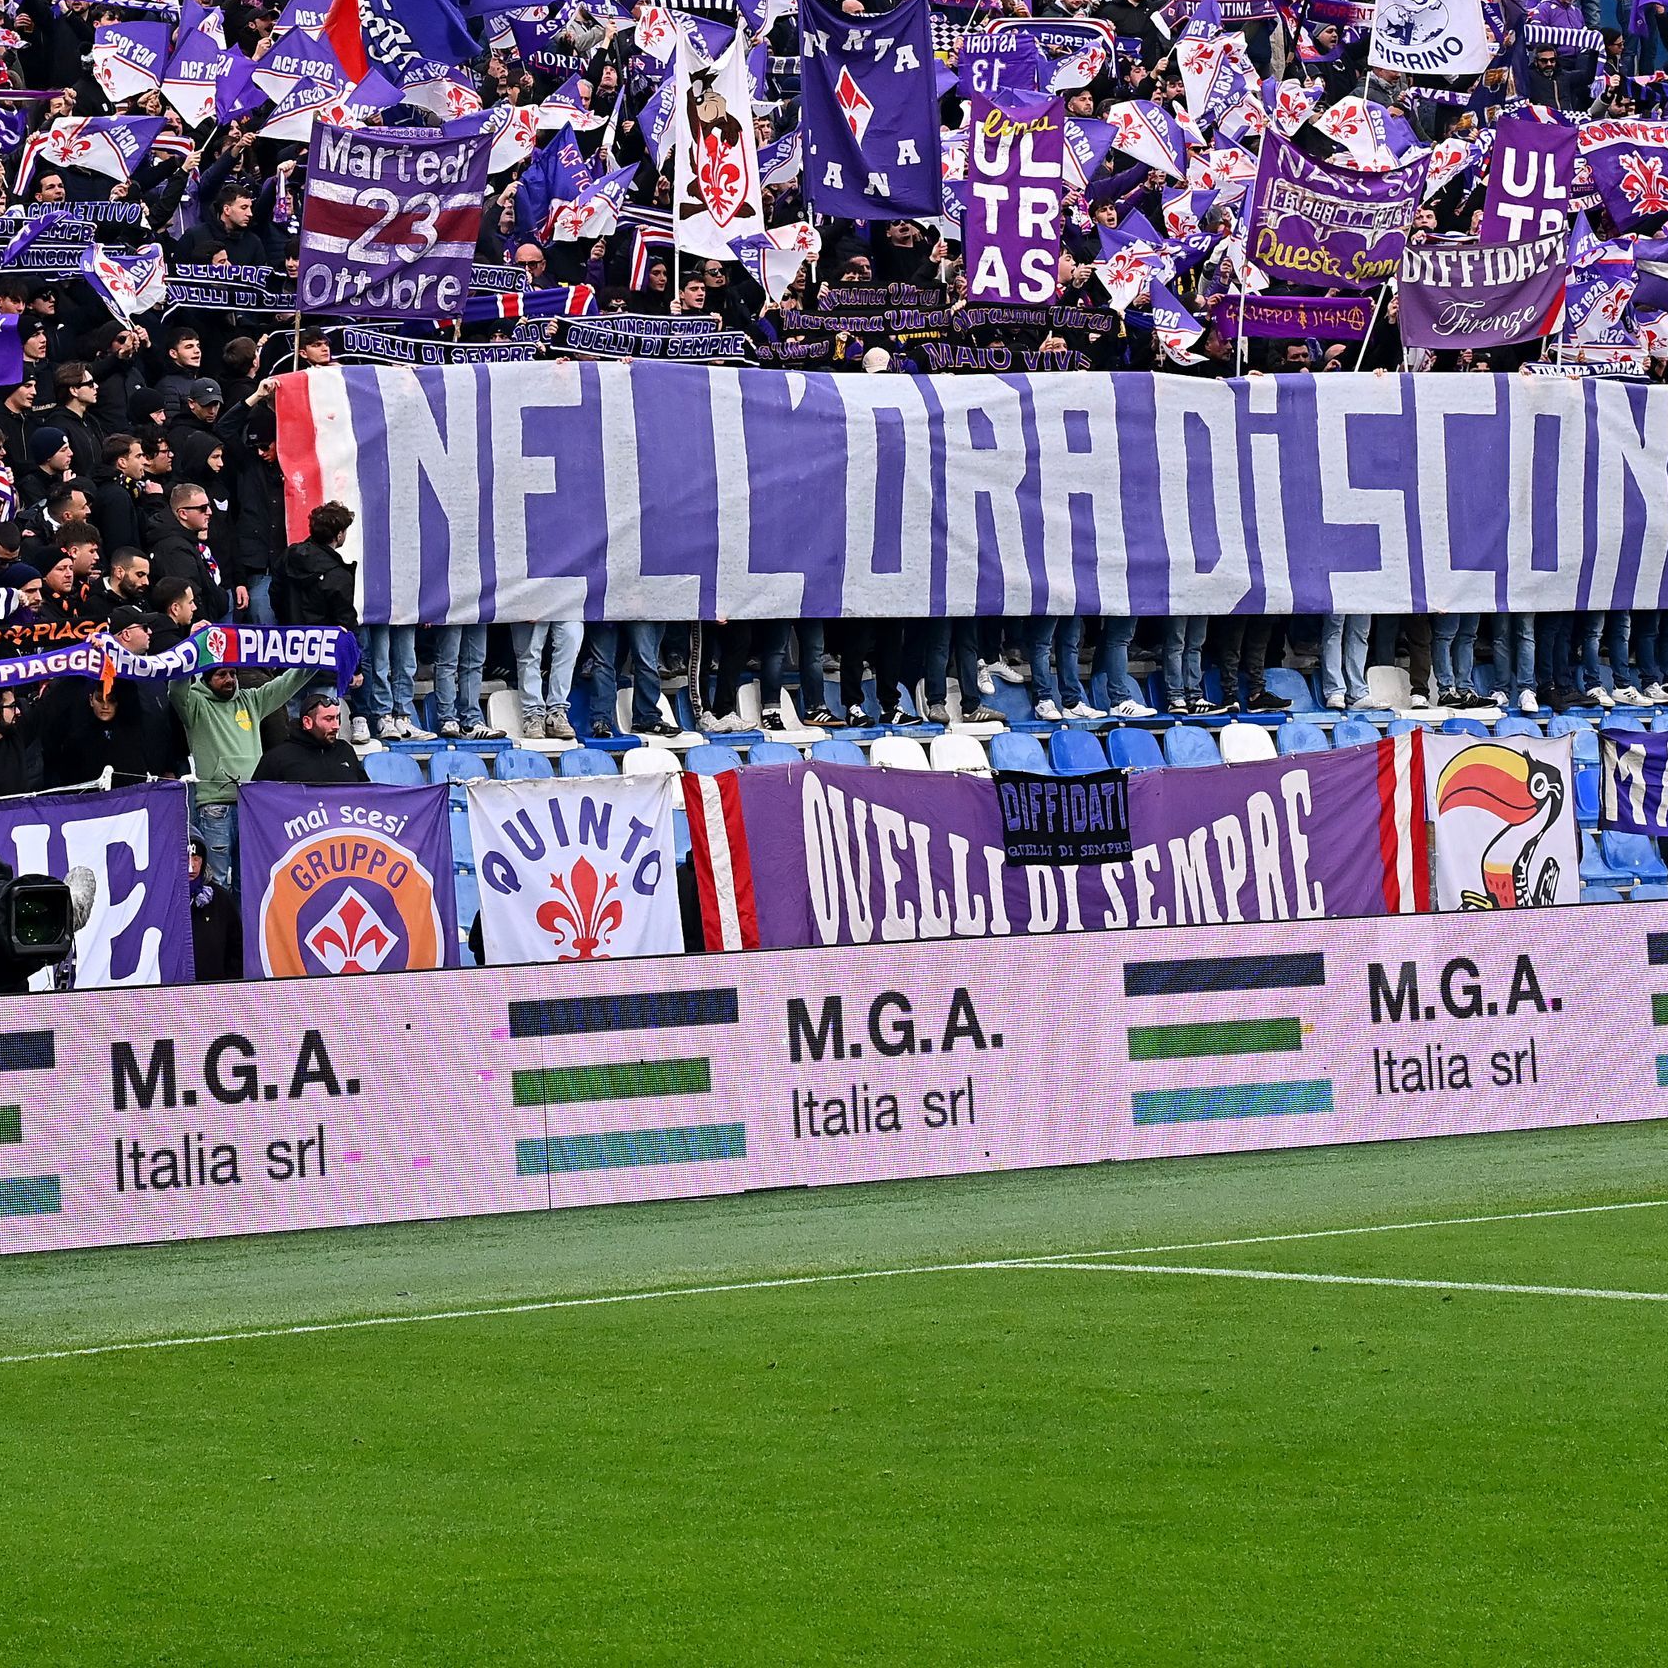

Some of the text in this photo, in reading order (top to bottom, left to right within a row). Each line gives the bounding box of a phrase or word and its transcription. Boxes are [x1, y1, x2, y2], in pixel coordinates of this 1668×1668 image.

[272, 57, 333, 79] ACF 1926
[973, 128, 1063, 178] UL
[1387, 169, 1422, 198] SU
[27, 201, 141, 225] COLLETTIVO
[348, 192, 441, 264] 23
[972, 183, 1060, 239] TR
[972, 245, 1057, 303] AS
[1255, 229, 1342, 276] Questa
[302, 263, 463, 313] Ottobre
[566, 327, 746, 358] QUELLI DI SEMPRE
[954, 303, 1114, 332] Marasma Ultras
[1433, 304, 1538, 342] Firenze
[343, 329, 536, 364] QUELLI DI SEMPRE
[927, 344, 1013, 371] MAIO
[377, 361, 1134, 623] NELL'ORA
[3, 654, 103, 683] PIAGGE
[284, 801, 410, 840] mai scesi
[1001, 779, 1129, 834] DIFFIDATI
[289, 843, 410, 893] GRUPPO
[483, 796, 663, 896] QUINTO
[1026, 859, 1082, 933] DI
[1102, 768, 1334, 930] SEMPRE
[1368, 954, 1562, 1023] M.G.A.
[788, 987, 1004, 1063] M.G.A.
[111, 1030, 360, 1112] M.G.A.
[1373, 1037, 1538, 1096] Italia srl
[792, 1077, 975, 1140] Italia srl
[115, 1124, 326, 1193] Italia srl
